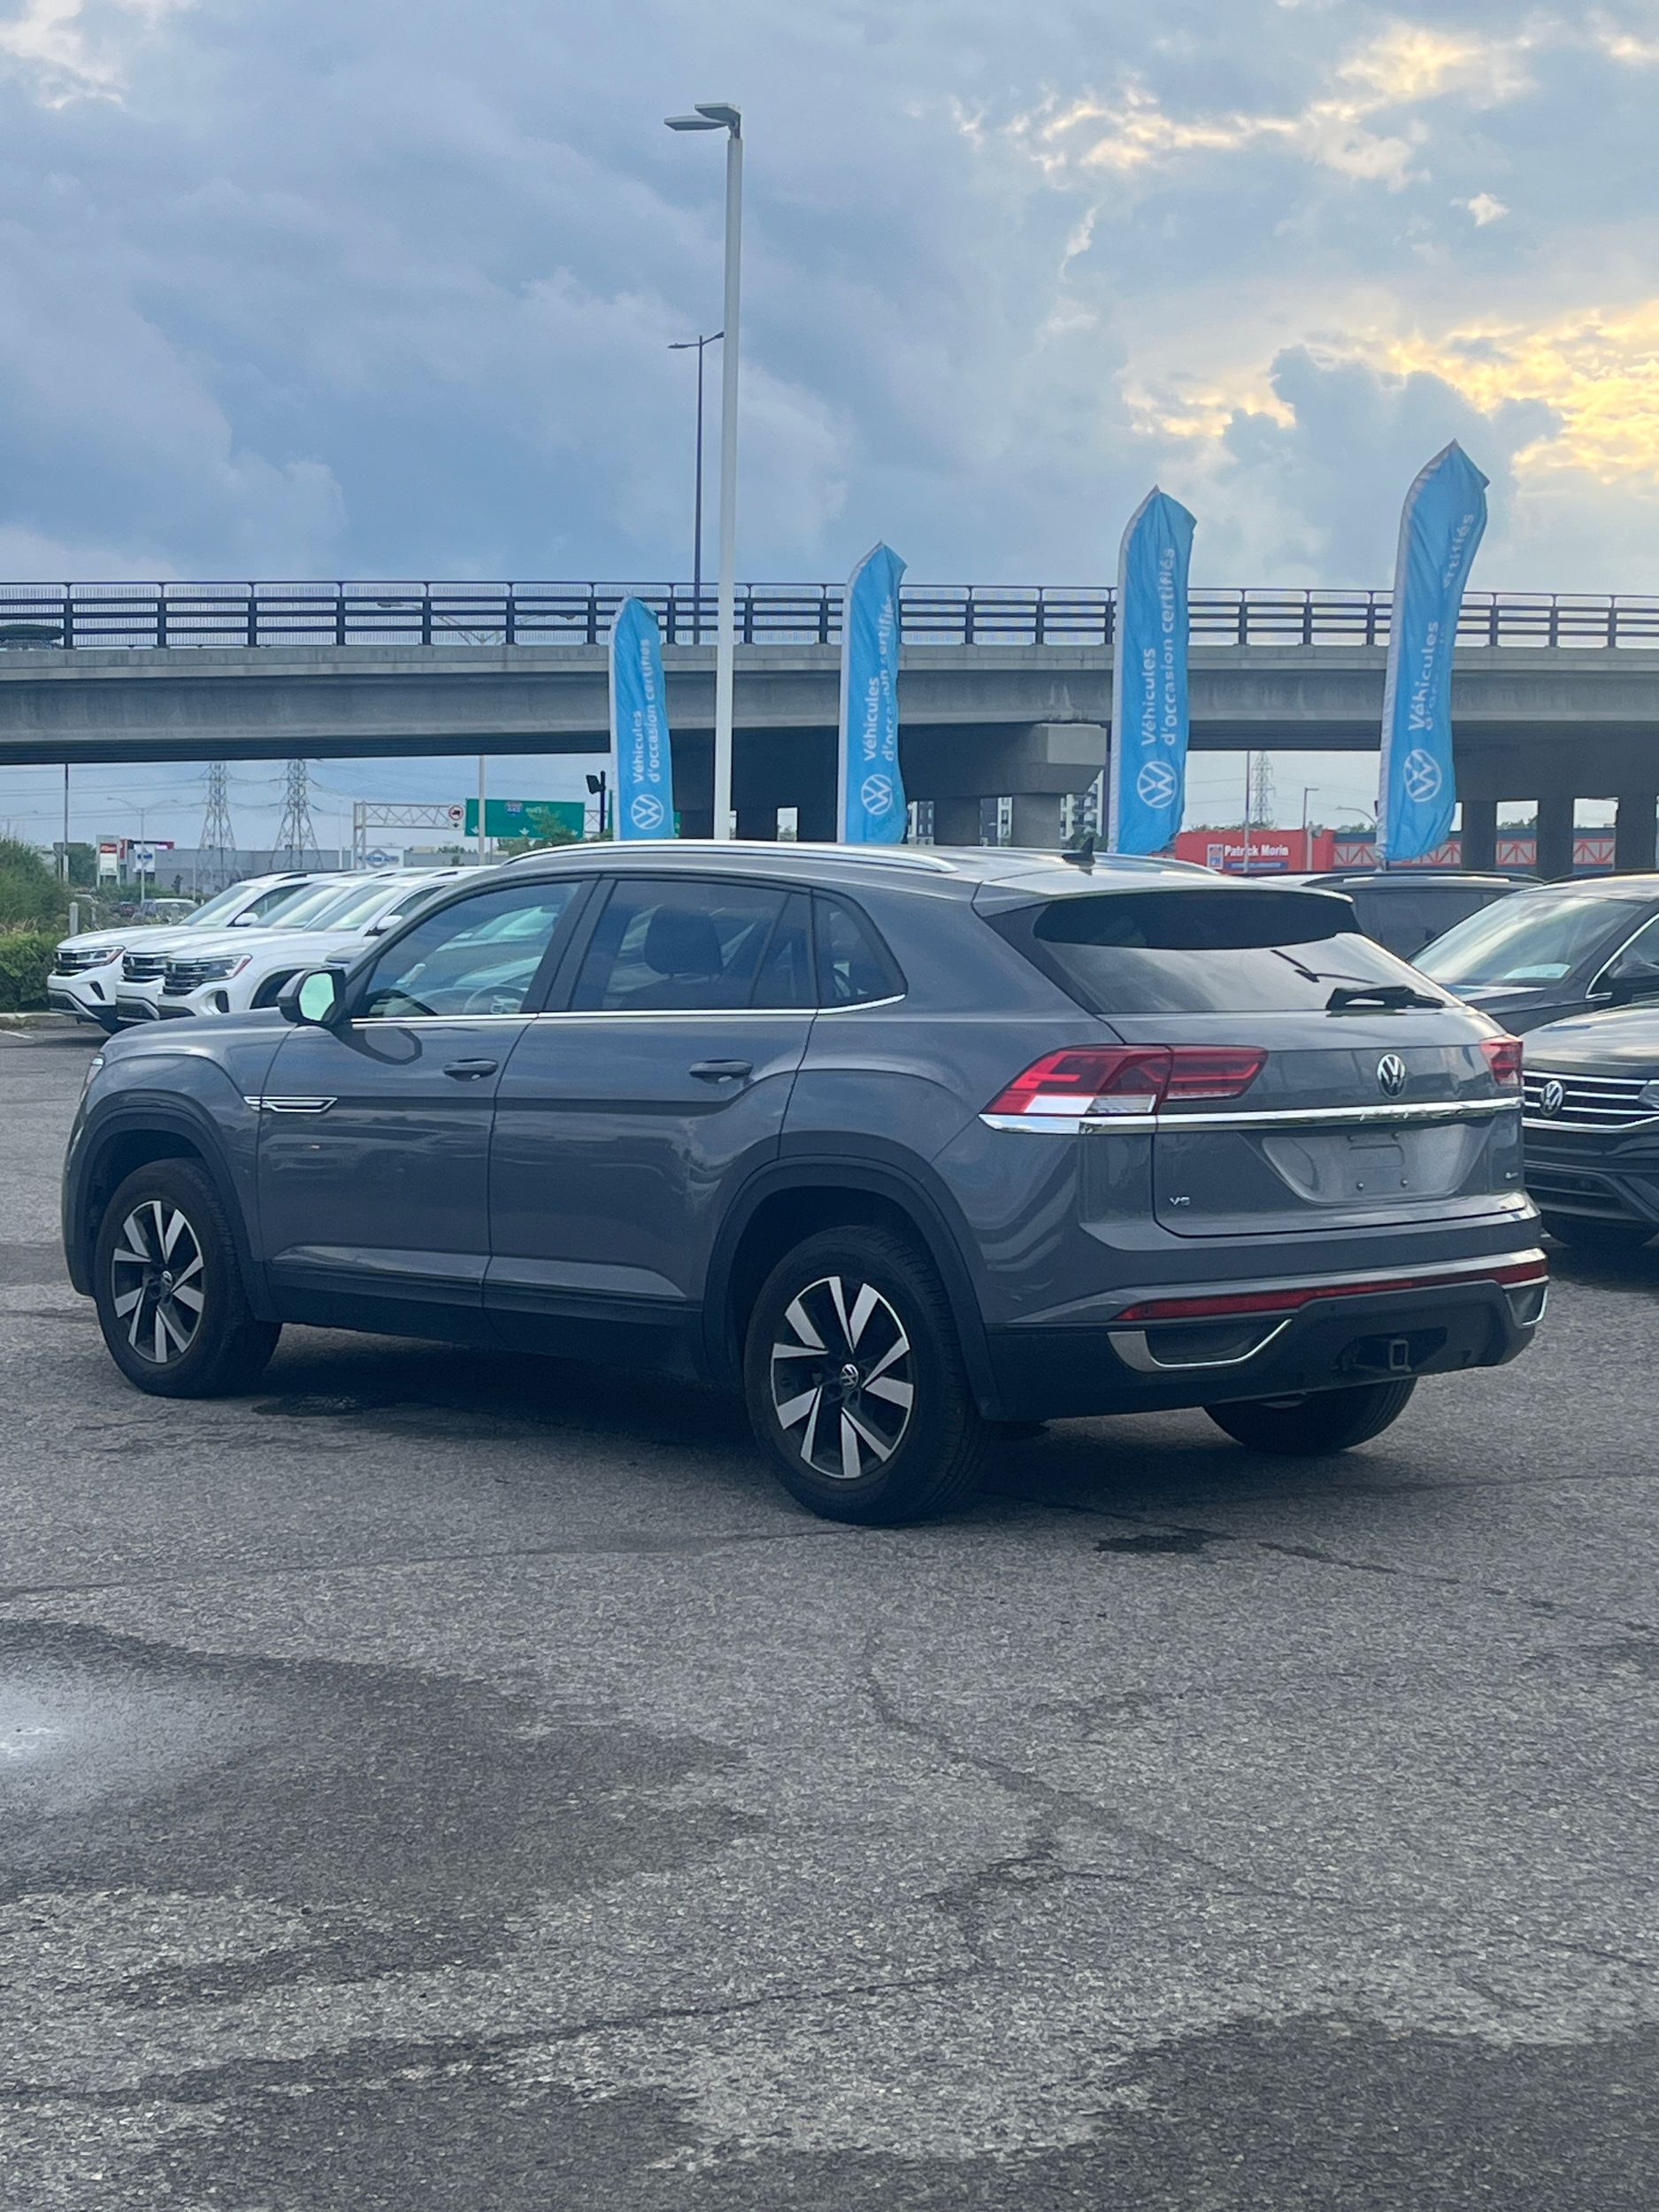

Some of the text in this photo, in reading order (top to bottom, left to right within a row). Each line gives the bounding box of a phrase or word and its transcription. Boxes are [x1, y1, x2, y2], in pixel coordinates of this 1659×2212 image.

[1441, 513, 1474, 589] ertifiés
[1156, 548, 1178, 746] d'occasion certifiés
[864, 677, 879, 761] Véhicules
[1141, 648, 1156, 746] Véhicules
[632, 710, 643, 784] Véhicules
[644, 704, 661, 783] d'occasion
[1224, 844, 1289, 856] Patrck Morin
